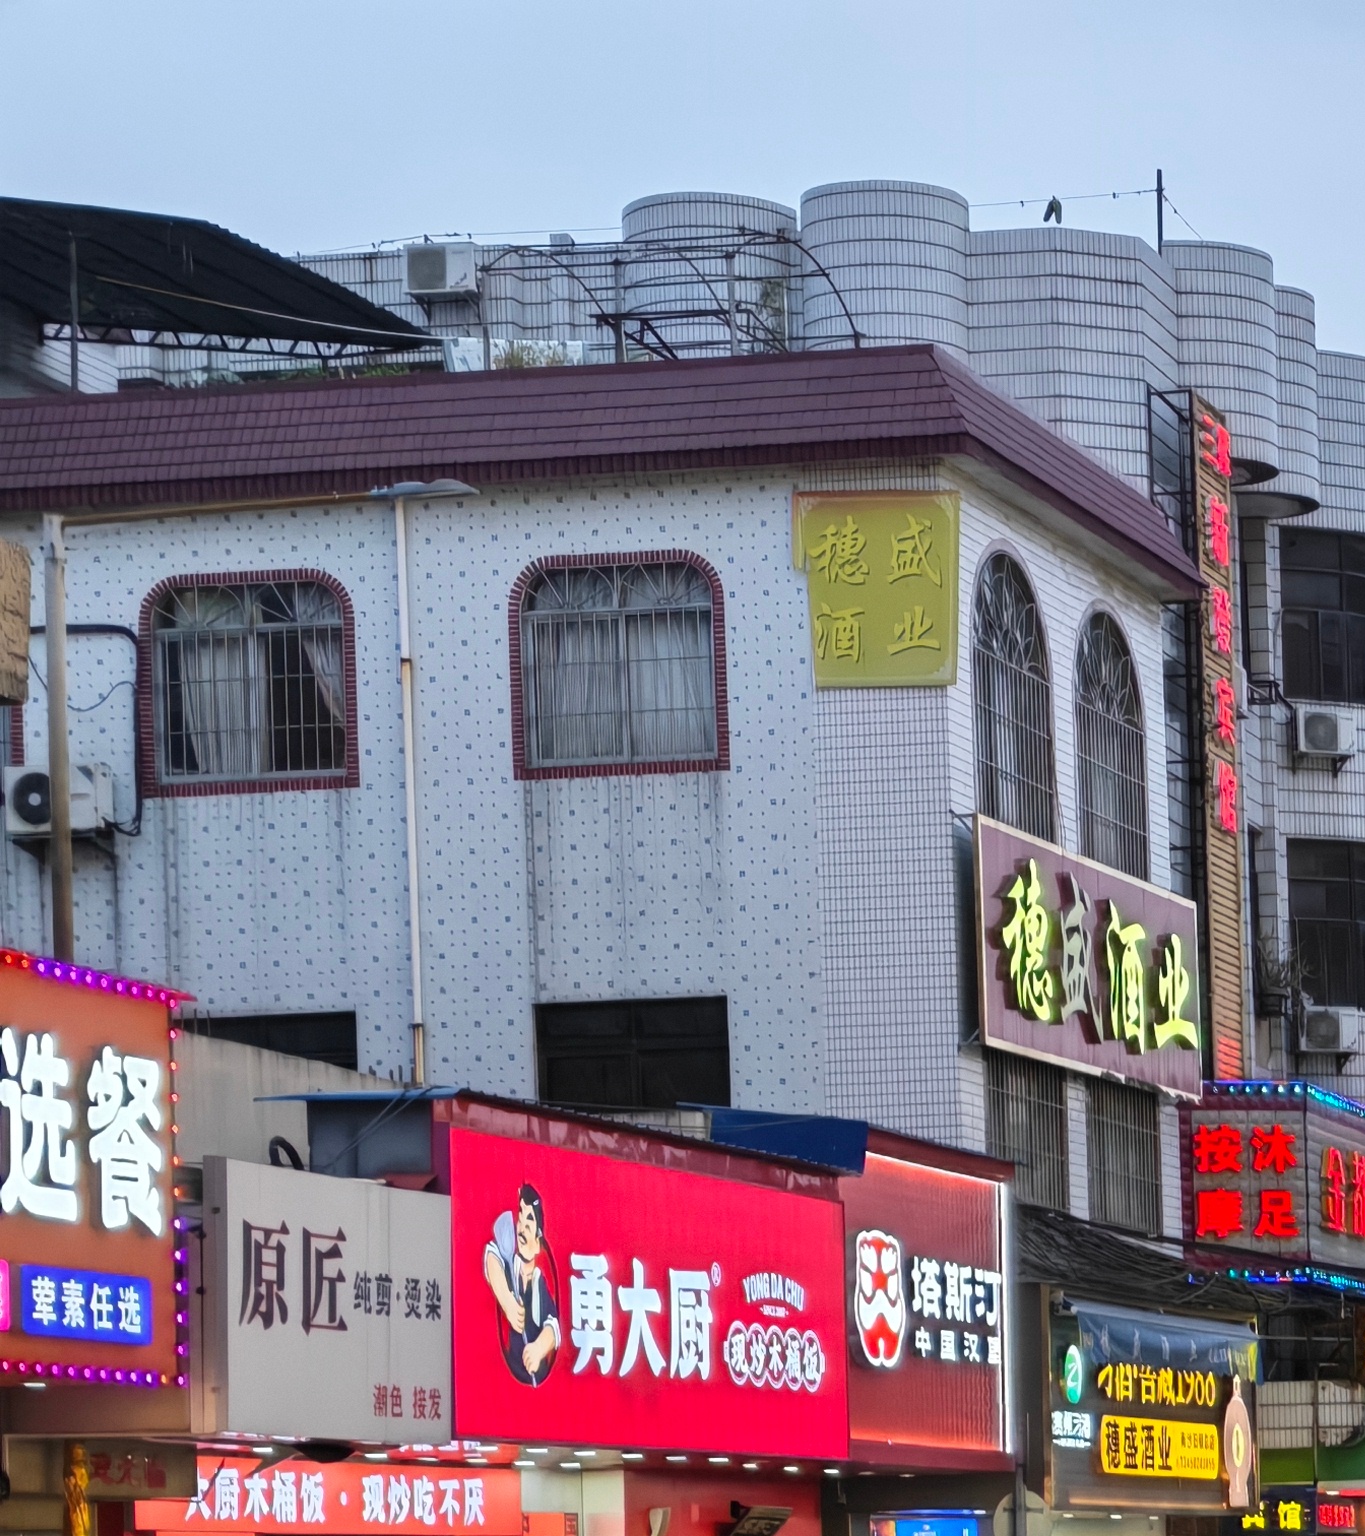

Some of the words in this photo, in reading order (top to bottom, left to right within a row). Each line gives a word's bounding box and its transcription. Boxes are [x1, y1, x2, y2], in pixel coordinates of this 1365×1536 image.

[807, 515, 943, 587] 穗盛
[815, 604, 941, 664] 酒业
[1002, 857, 1199, 1055] 穗盛酒业
[31, 1276, 141, 1334] 荤素任选
[239, 1218, 348, 1336] 原匠
[743, 1272, 769, 1303] YONG
[771, 1272, 783, 1300] DA
[785, 1276, 805, 1311] CHU
[911, 1255, 1001, 1326] 塔斯汀
[570, 1252, 713, 1380] 勇大厨
[730, 1334, 819, 1382] 现炒木桶饭
[374, 1384, 403, 1418] 潮色
[413, 1386, 442, 1421] 接发
[1105, 1419, 1173, 1472] 穗盛酒业
